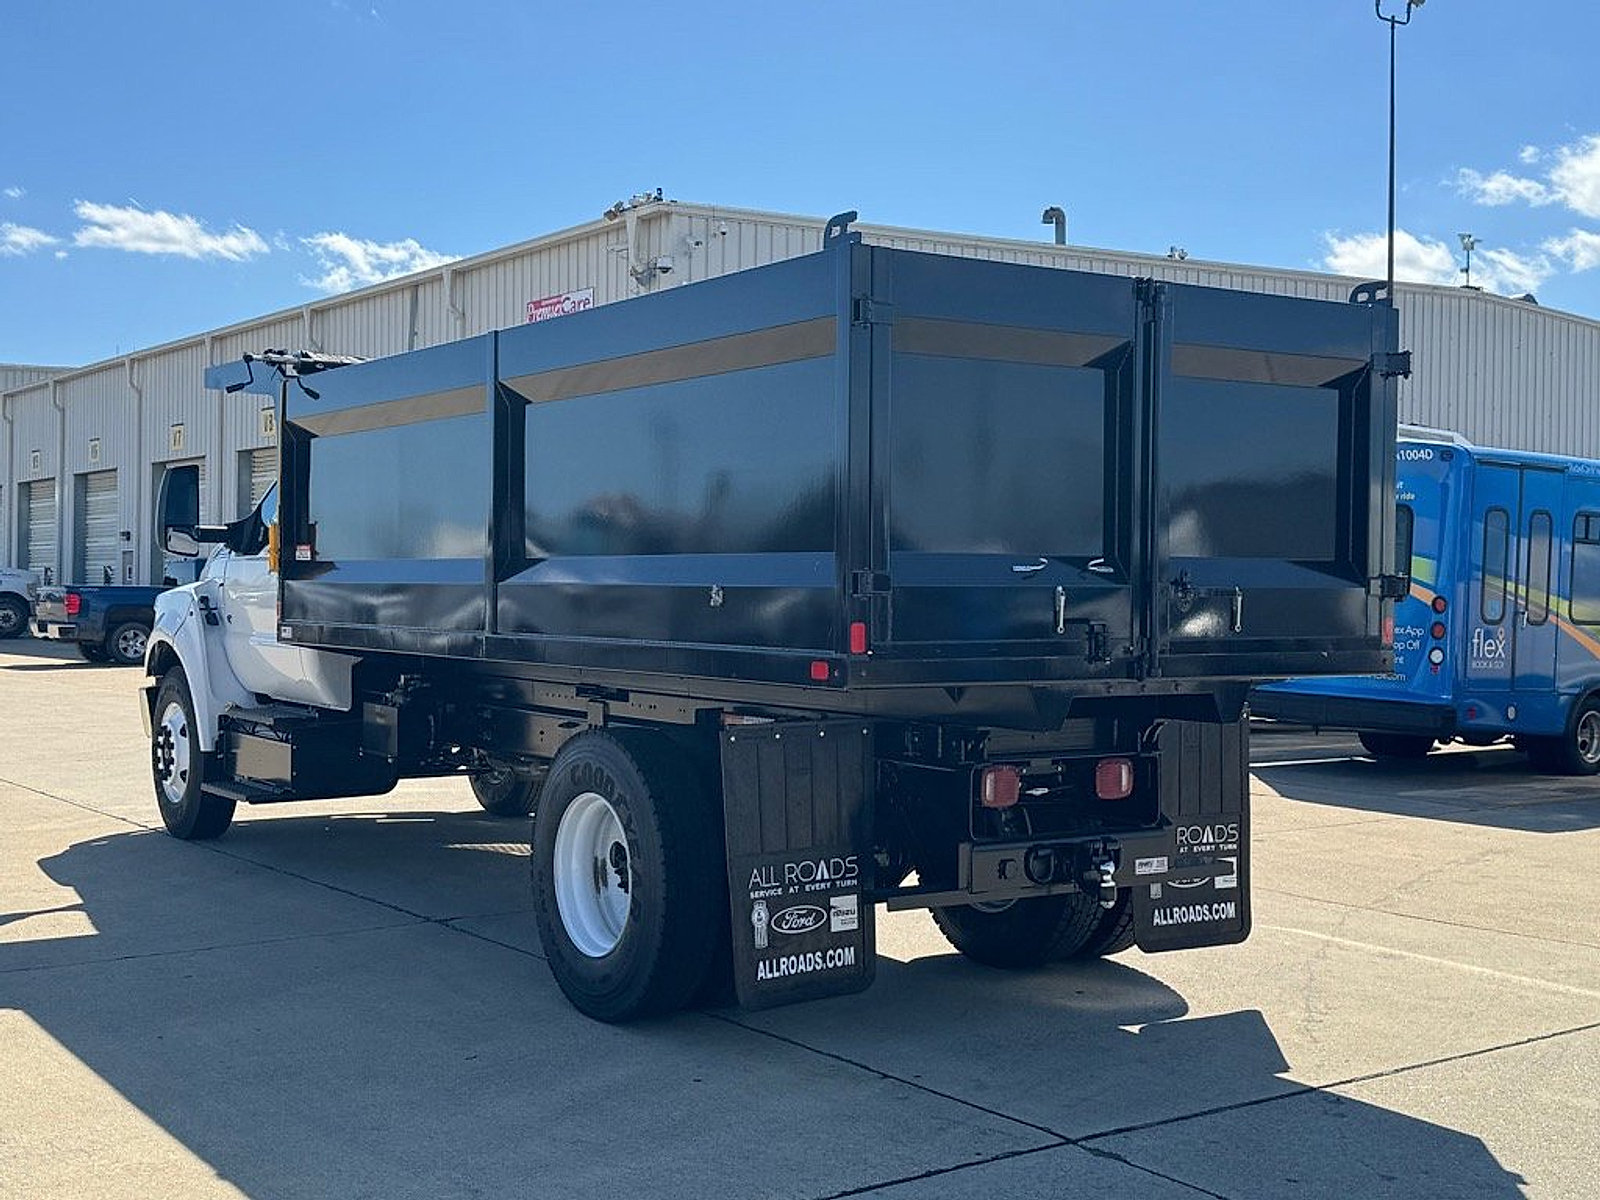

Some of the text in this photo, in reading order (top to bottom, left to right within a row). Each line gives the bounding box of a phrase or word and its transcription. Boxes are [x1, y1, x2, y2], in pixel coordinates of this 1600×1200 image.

[1472, 627, 1506, 658] flex
[1176, 823, 1239, 845] ROADS
[749, 856, 859, 889] ALL ROADS
[750, 879, 858, 899] SERVICE AT EVERY TURN
[781, 909, 817, 930] Ford
[1152, 901, 1236, 927] ALLROADS.COM
[757, 946, 856, 981] ALLROADS.COM
